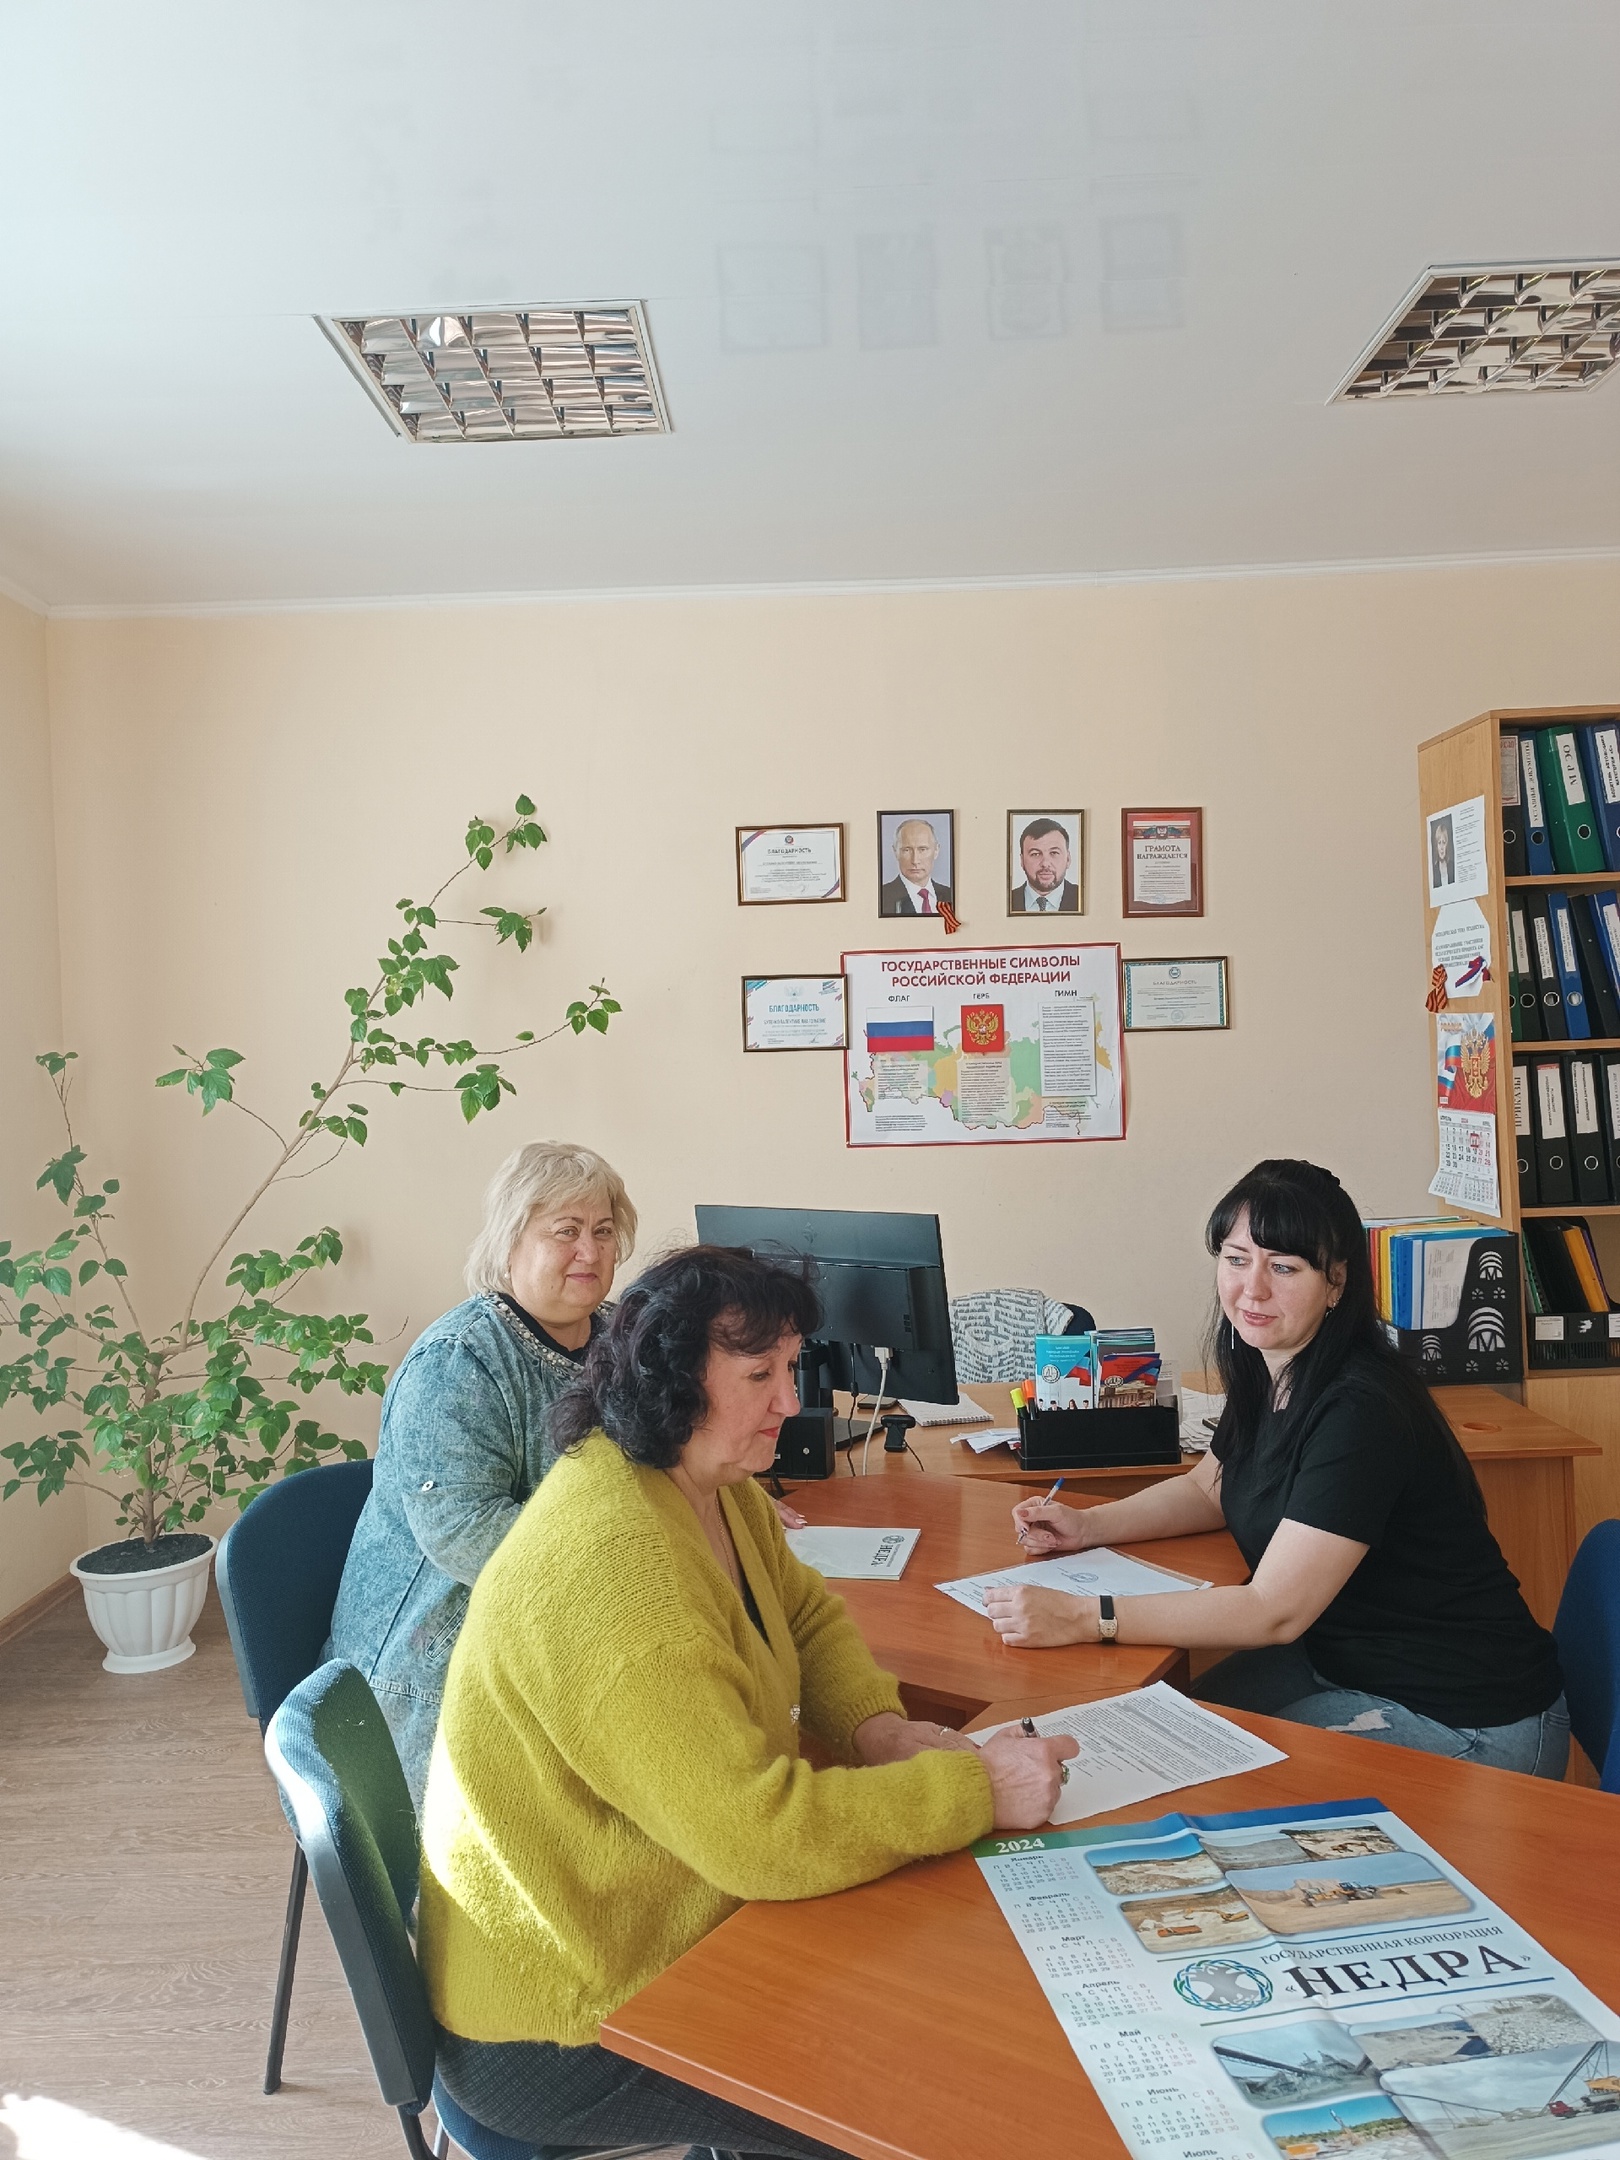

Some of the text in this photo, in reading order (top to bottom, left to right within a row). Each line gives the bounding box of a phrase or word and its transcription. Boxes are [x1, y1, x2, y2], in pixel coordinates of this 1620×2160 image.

[881, 956, 1080, 973] ГОСУДАРСТВЕННЫЕ СИМВОЛЫ
[892, 971, 1071, 987] РОССИЙСКОЙ ФЕДЕРАЦИИ
[973, 992, 990, 1000] ГЕРБ
[768, 1004, 820, 1012] БЛАГОДАРНОСТЬ
[1514, 1077, 1522, 1127] ПРИКАЗЫ
[996, 1838, 1045, 1853] 2024
[1029, 1893, 1070, 1901] Февраль
[1260, 1926, 1504, 1965] ГОСУДАРСТВЕННАЯ КОРПОРАЦИЯ
[1283, 1945, 1531, 1998] «НЕДРА»
[1082, 1980, 1120, 1988] Апрель
[1118, 2029, 1141, 2037] Май
[1183, 2150, 1218, 2158] Июль
